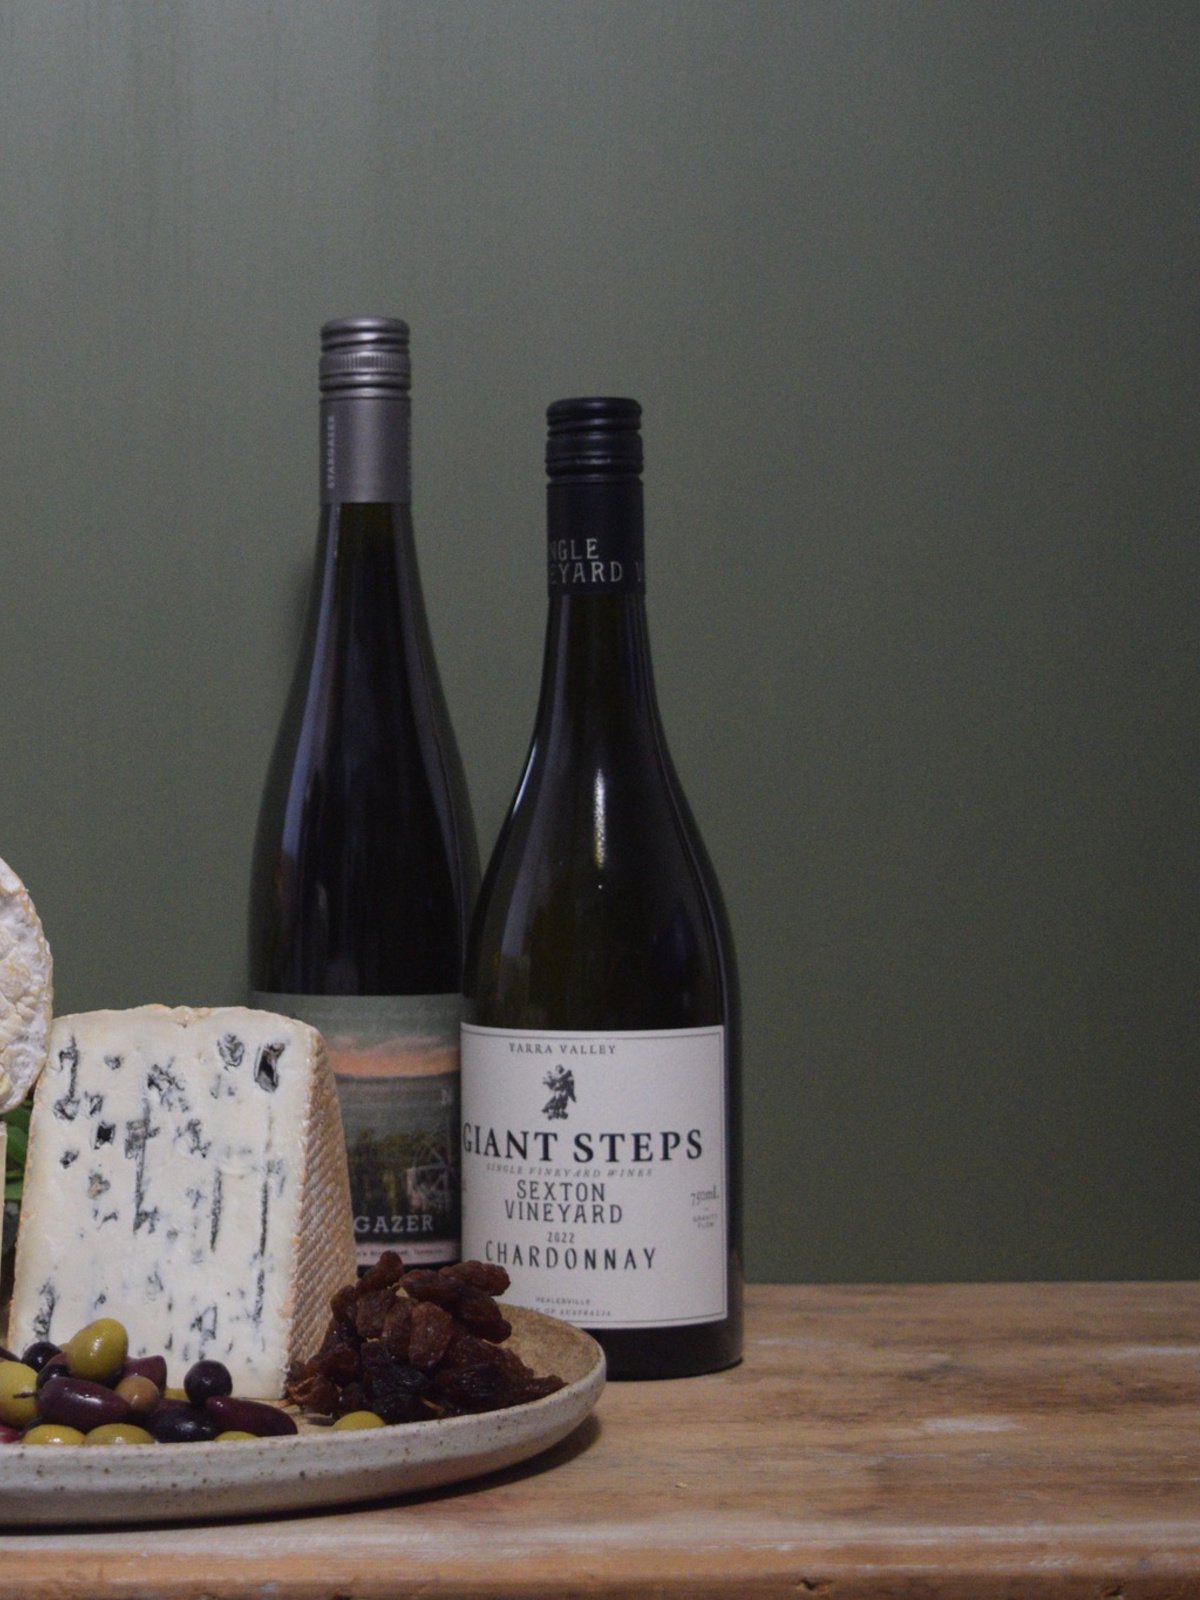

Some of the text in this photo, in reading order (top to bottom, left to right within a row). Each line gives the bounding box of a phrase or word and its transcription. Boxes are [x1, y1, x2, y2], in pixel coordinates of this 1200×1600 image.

[509, 1042, 616, 1055] YARRA VALLEY
[462, 1122, 703, 1163] GIANT STEPS
[486, 1163, 653, 1178] SINGLE VINEYARD WINES
[517, 1179, 605, 1202] SEXTON
[505, 1200, 623, 1224] VINEYARD
[354, 1214, 434, 1233] GAZER
[547, 1231, 575, 1243] 2022
[485, 1240, 656, 1270] CHARDONNAY
